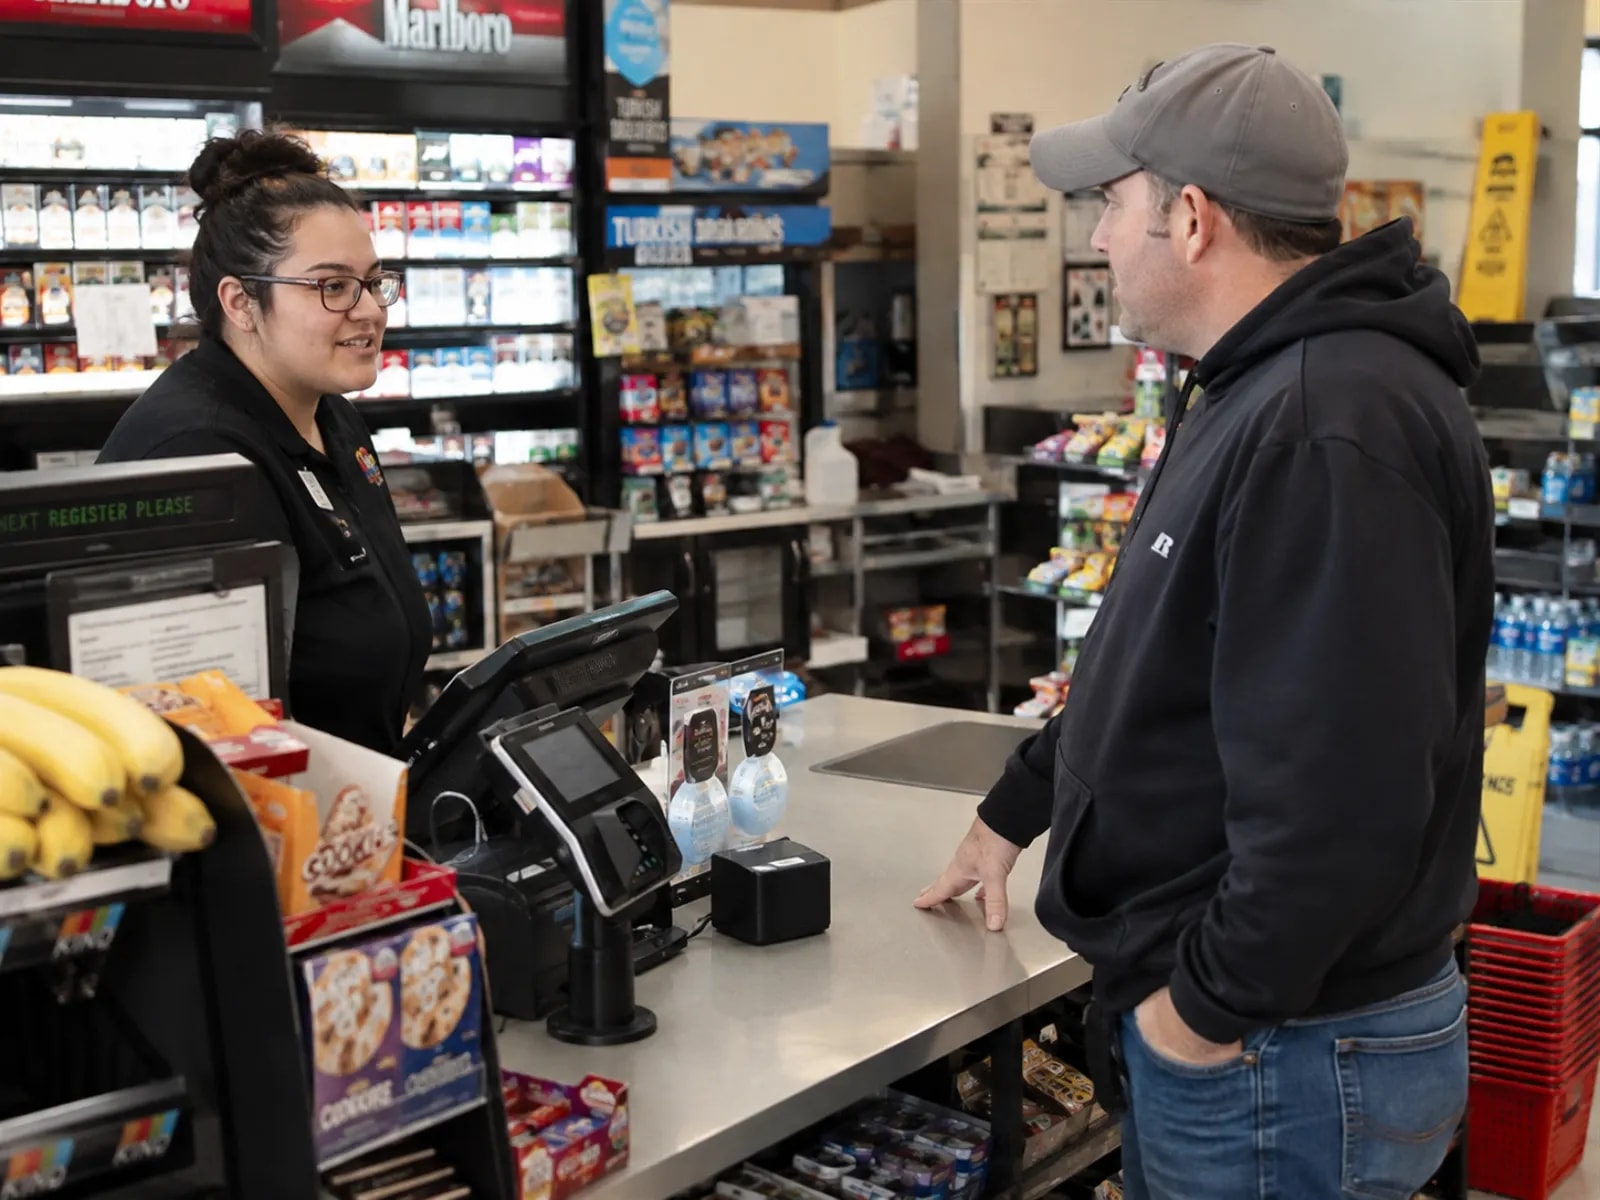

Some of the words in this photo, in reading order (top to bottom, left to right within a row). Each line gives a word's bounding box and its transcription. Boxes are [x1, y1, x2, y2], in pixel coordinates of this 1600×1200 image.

[383, 0, 513, 54] Marlboro
[50, 503, 128, 528] REGISTER
[136, 496, 193, 518] PLEASE
